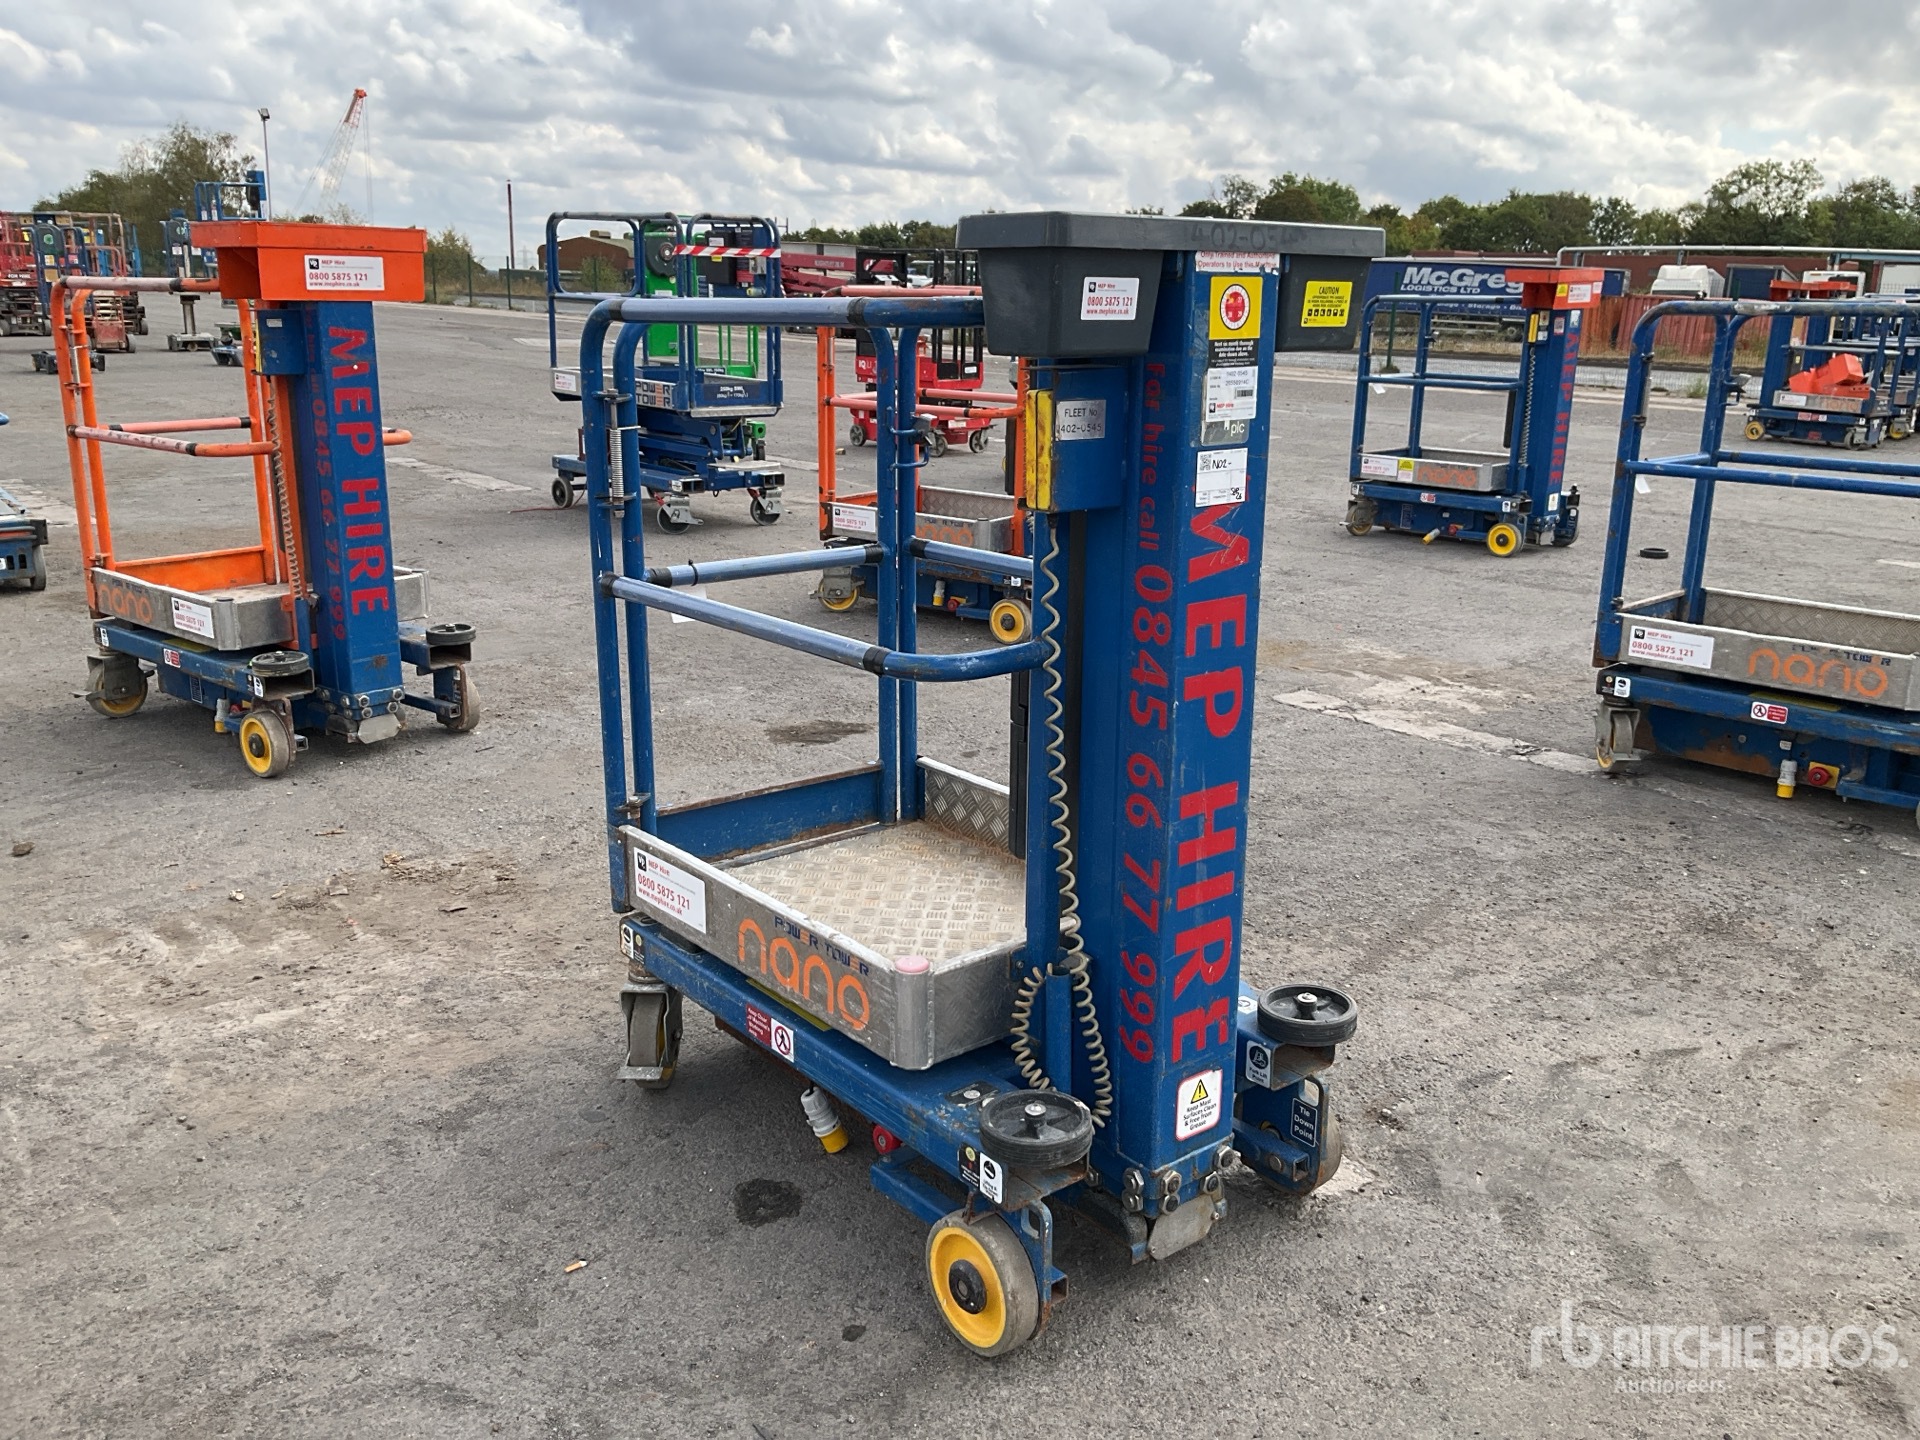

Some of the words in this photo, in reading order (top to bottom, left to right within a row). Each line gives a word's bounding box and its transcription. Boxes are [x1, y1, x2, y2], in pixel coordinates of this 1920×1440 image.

[309, 272, 329, 280] 0800
[1400, 284, 1458, 294] LOGISTICS
[1460, 286, 1480, 294] LTD
[1088, 297, 1103, 306] 0800
[1105, 297, 1120, 306] 5875
[1123, 297, 1133, 306] 121
[328, 315, 376, 456] MEP
[636, 383, 671, 395] POWER
[636, 394, 671, 407] TOWER
[1145, 363, 1165, 411] For
[1064, 408, 1086, 417] FLEET
[1089, 408, 1098, 417] No
[1230, 421, 1245, 437] plc
[312, 399, 332, 477] 0845
[1142, 424, 1165, 485] hire
[1139, 497, 1160, 550] call
[341, 478, 390, 616] HIRE
[100, 585, 153, 623] nano
[1183, 474, 1251, 738] MEP
[1128, 564, 1173, 730] 0845
[1632, 641, 1653, 651] 0800
[1655, 645, 1675, 654] 5875
[1679, 649, 1694, 657] 121
[1749, 648, 1888, 697] nano
[1125, 752, 1164, 830] 66
[648, 860, 658, 870] MEP
[638, 873, 655, 891] 0800
[657, 884, 675, 902] 5875
[677, 895, 690, 910] 121
[1122, 853, 1161, 934] 77
[1171, 780, 1239, 1064] HIRE
[774, 916, 818, 950] POWER
[825, 943, 869, 976] TOWER
[738, 918, 870, 1030] nano
[1118, 950, 1157, 1064] 999
[1183, 1109, 1203, 1121] Surfaces
[1204, 1103, 1217, 1112] Clean
[1187, 1105, 1199, 1113] Keep
[1294, 1114, 1314, 1130] Down
[1299, 1105, 1311, 1117] Tie
[1294, 1125, 1313, 1140] Point
